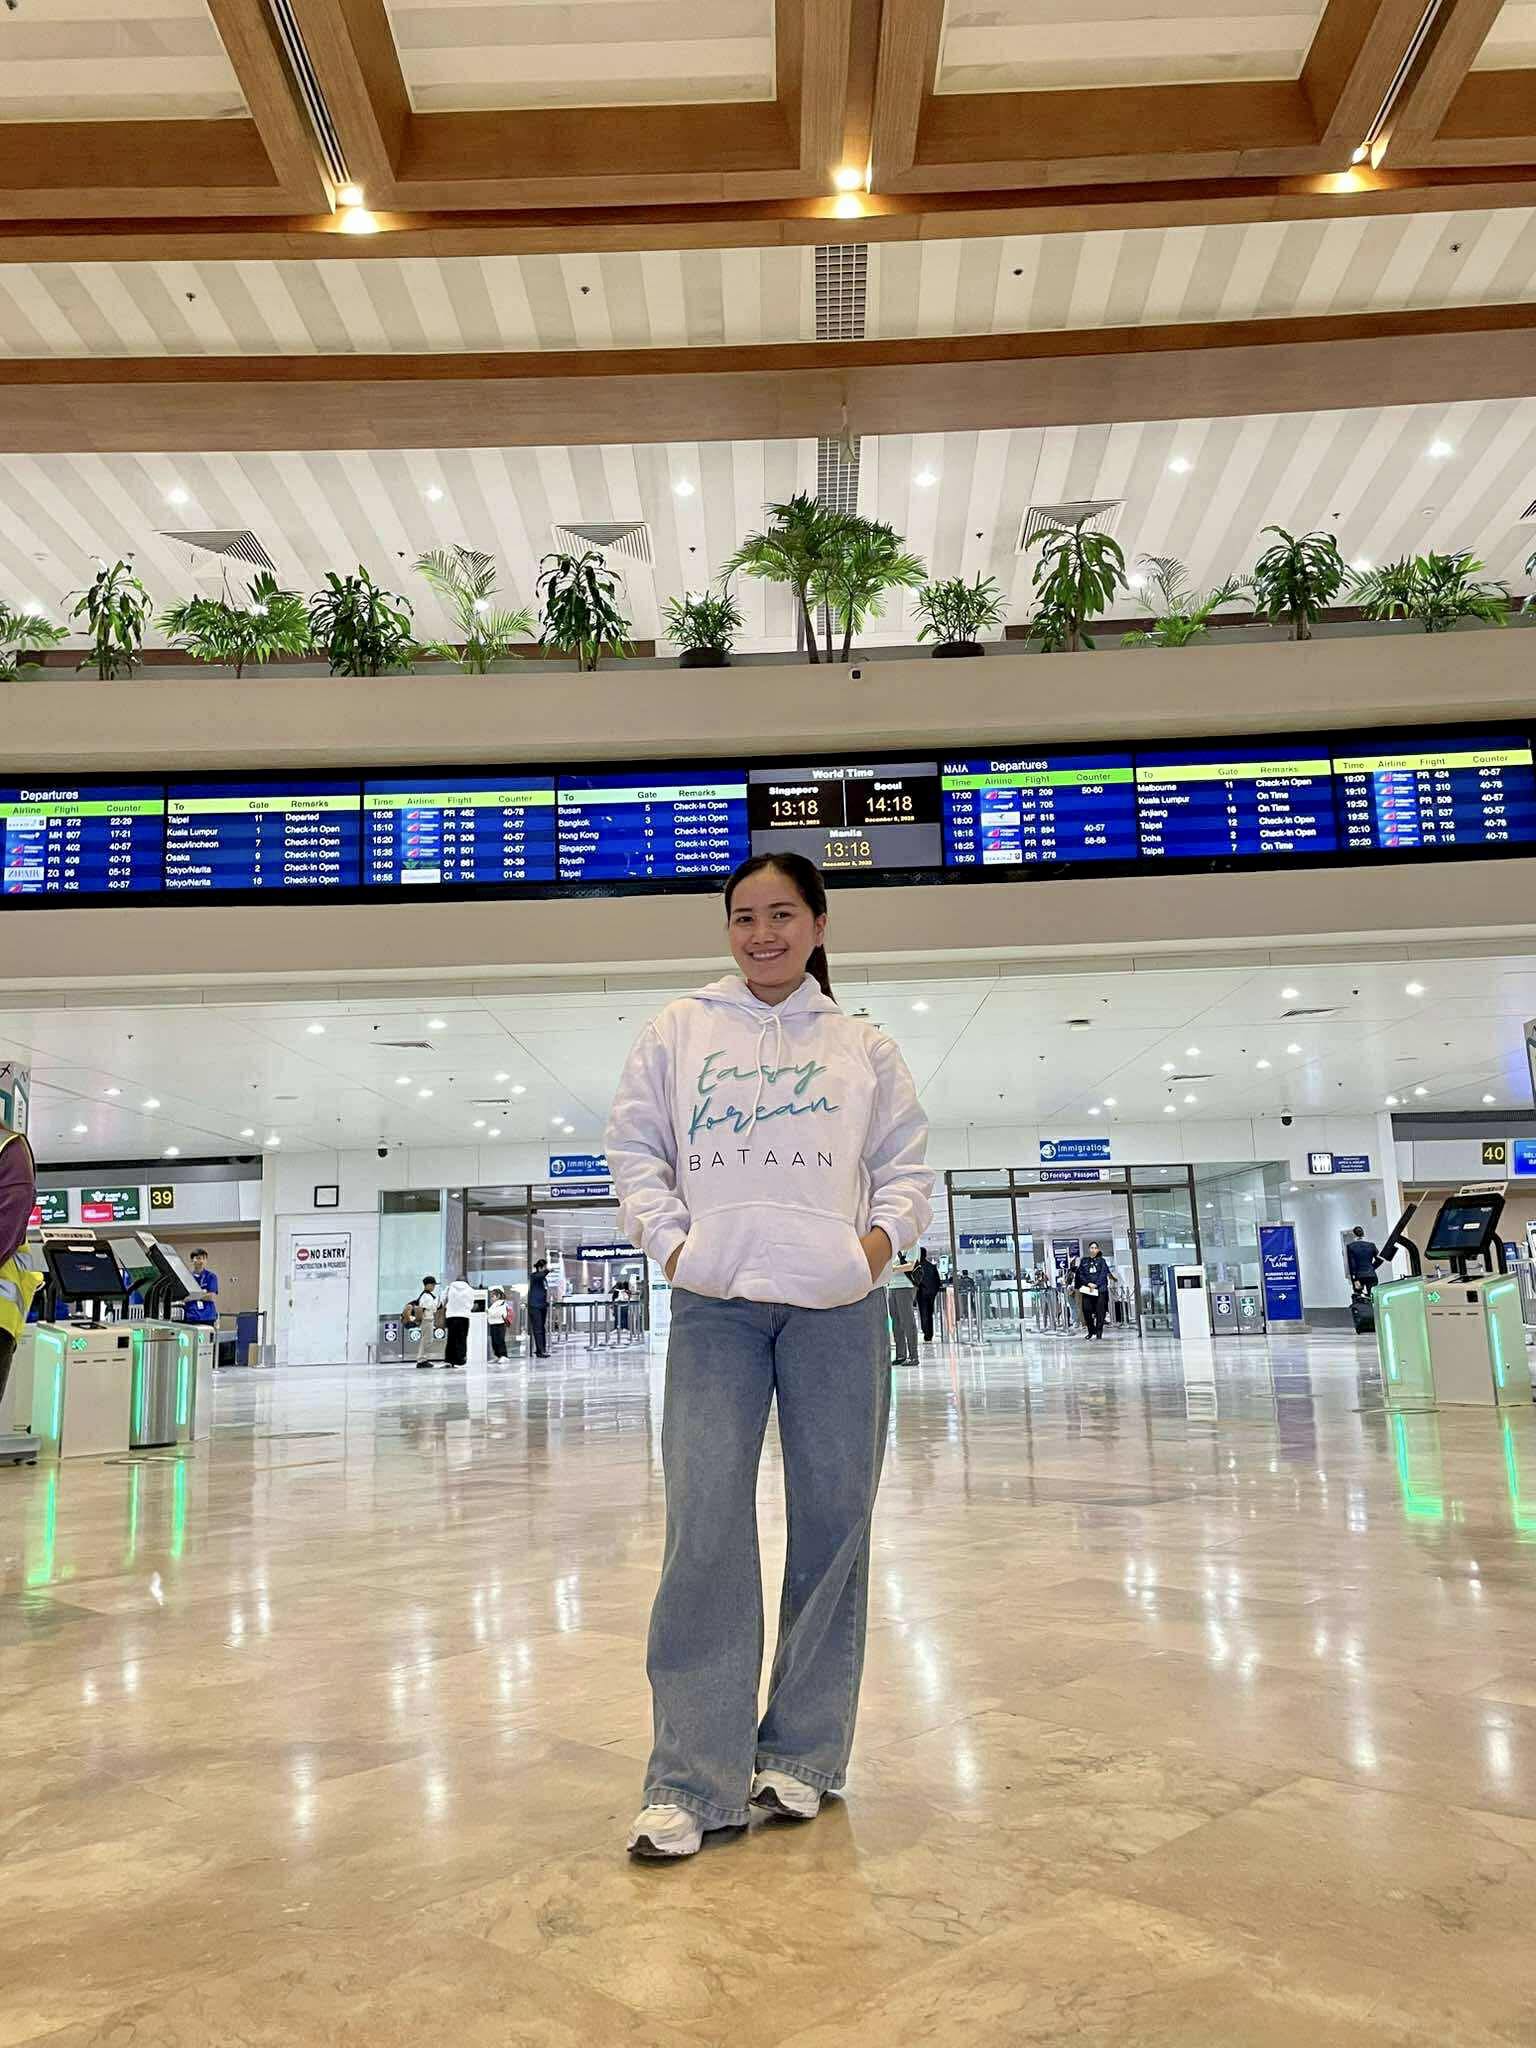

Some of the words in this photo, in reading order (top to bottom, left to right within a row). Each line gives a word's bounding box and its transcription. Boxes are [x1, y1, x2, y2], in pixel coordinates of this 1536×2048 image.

[944, 765, 968, 773] NAIA
[990, 761, 1048, 772] Departures
[812, 769, 844, 779] World
[847, 768, 874, 777] Time
[1025, 776, 1050, 784] Flight
[1138, 783, 1177, 791] Melbourne
[1291, 778, 1312, 786] Open
[769, 786, 819, 796] Singapore
[874, 782, 903, 791] Seoul
[20, 790, 78, 801] Departures
[1139, 796, 1160, 804] Kuala
[1162, 796, 1189, 804] Lumpur
[1257, 792, 1270, 800] On
[175, 803, 184, 811] To
[708, 802, 728, 810] Open
[772, 800, 818, 816] 13:18
[866, 795, 912, 813] 14:18
[952, 804, 972, 812] 17:20
[54, 806, 79, 814] Flight
[1139, 809, 1168, 818] Jinjiang
[1271, 804, 1290, 812] Time
[1421, 809, 1433, 817] PR
[1483, 806, 1504, 814] 40-57
[286, 813, 319, 821] Departed
[559, 819, 590, 828] Bangkok
[708, 814, 728, 822] Open
[1023, 814, 1035, 822] MF
[1140, 822, 1162, 830] Taipei
[1294, 816, 1315, 824] Open
[1348, 825, 1370, 833] 20:10
[1440, 821, 1455, 829] 732
[190, 828, 218, 837] Lumpur
[559, 832, 578, 840] Hong
[580, 831, 599, 840] Kong
[709, 827, 728, 835] Open
[829, 829, 862, 838] Manila
[1295, 829, 1316, 837] Open
[319, 838, 340, 846] Open
[559, 844, 596, 853] Singapore
[709, 839, 729, 847] Open
[1025, 839, 1036, 847] PR
[503, 845, 524, 853] 40-57
[824, 841, 870, 857] 13:18
[1142, 847, 1164, 855] Taipei
[1261, 842, 1273, 850] On
[319, 851, 340, 859] Open
[559, 857, 585, 865] Riyadh
[710, 852, 729, 860] Open
[8, 869, 40, 878] ZIPAIR
[166, 867, 212, 875] Tokyo/Narita
[319, 863, 339, 871] Open
[710, 864, 730, 872] Open
[166, 879, 211, 887] Tokyo/Narita
[319, 876, 339, 884] Open
[688, 1096, 840, 1144] Korean
[1484, 1147, 1504, 1160] 40
[689, 1149, 833, 1171] BATAAN
[153, 1191, 172, 1205] 39
[311, 1249, 320, 1259] NO
[323, 1248, 346, 1258] ENTRY
[616, 1248, 643, 1256] Passport
